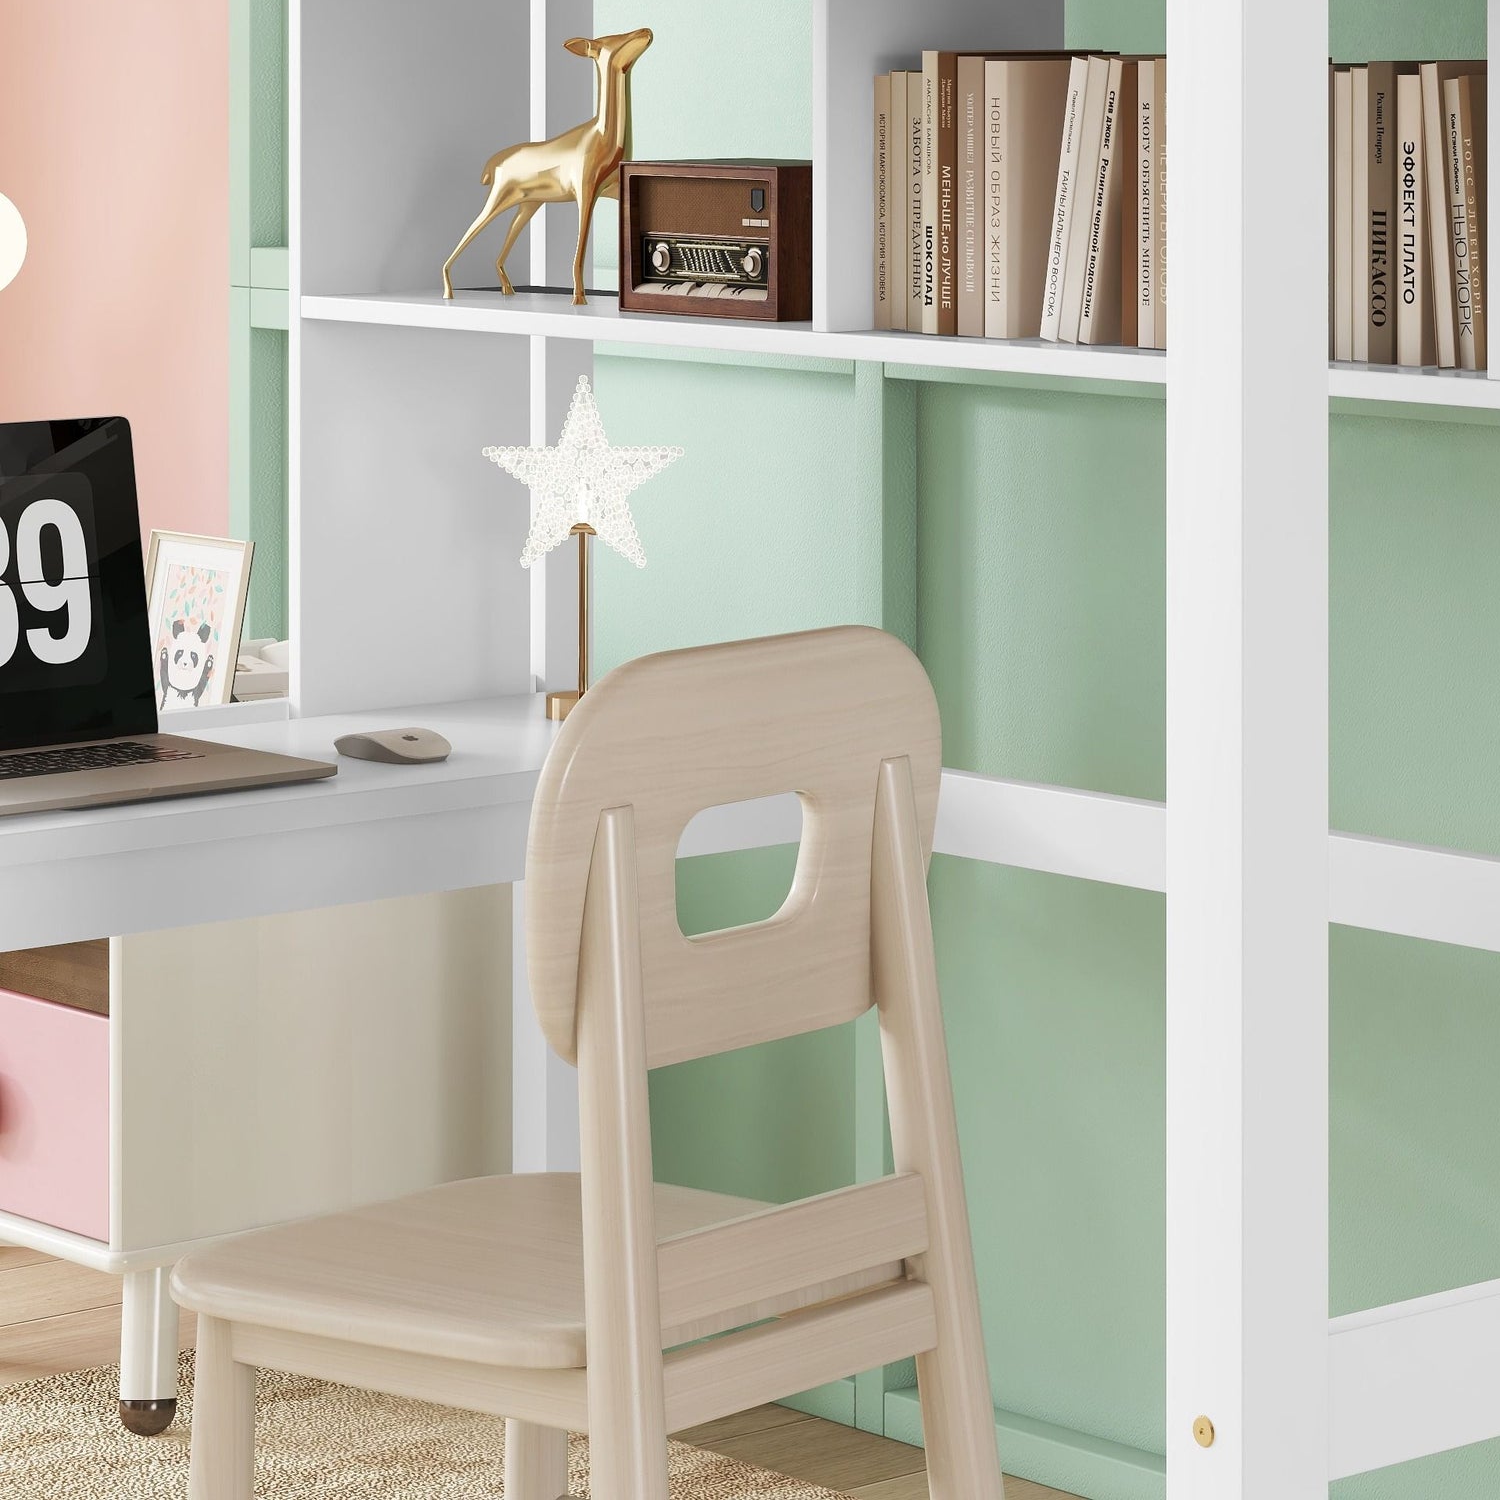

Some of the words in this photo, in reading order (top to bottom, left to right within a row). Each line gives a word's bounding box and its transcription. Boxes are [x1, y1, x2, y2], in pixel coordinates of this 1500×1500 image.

[878, 113, 886, 151] ИСТОРИЯ
[990, 97, 1002, 164] НОВЫЙ
[1142, 102, 1150, 110] Я
[1142, 115, 1150, 153] МОГУ
[1375, 92, 1385, 125] Роланд
[912, 117, 921, 176] ЗАБОТА
[1374, 127, 1385, 164] Пенроуз
[1463, 138, 1474, 187] РОСС
[877, 152, 886, 220] МАКРОКОСМОСА,
[912, 183, 921, 194] О
[990, 170, 1001, 228] ОБРАЗ
[1096, 158, 1109, 208] Религия
[1142, 159, 1150, 243] ОБЪЯСНИТЬ
[1402, 141, 1416, 227] ЭФФЕКТ
[1453, 158, 1461, 195] Робинсон
[878, 222, 886, 259] ИСТОРИЯ
[911, 199, 921, 300] ПРЕДАННЫХ
[1091, 209, 1102, 253] черной
[1468, 196, 1482, 315] ЭЛЛЕНХОРН
[878, 260, 886, 302] ЧЕЛОВЕКА
[925, 226, 933, 307] ШОКОЛАД
[941, 256, 951, 309] ЛУЧШЕ
[990, 234, 1001, 303] ЖИЗНИ
[1046, 267, 1059, 318] ВОСТОКА
[1083, 255, 1097, 318] водолазки
[1142, 248, 1150, 307] МНОГОЕ
[1371, 210, 1387, 328] ПИКАССО
[1403, 234, 1415, 305] ПЛАТО
[1452, 204, 1473, 337] НЬЮ-ЙОРК
